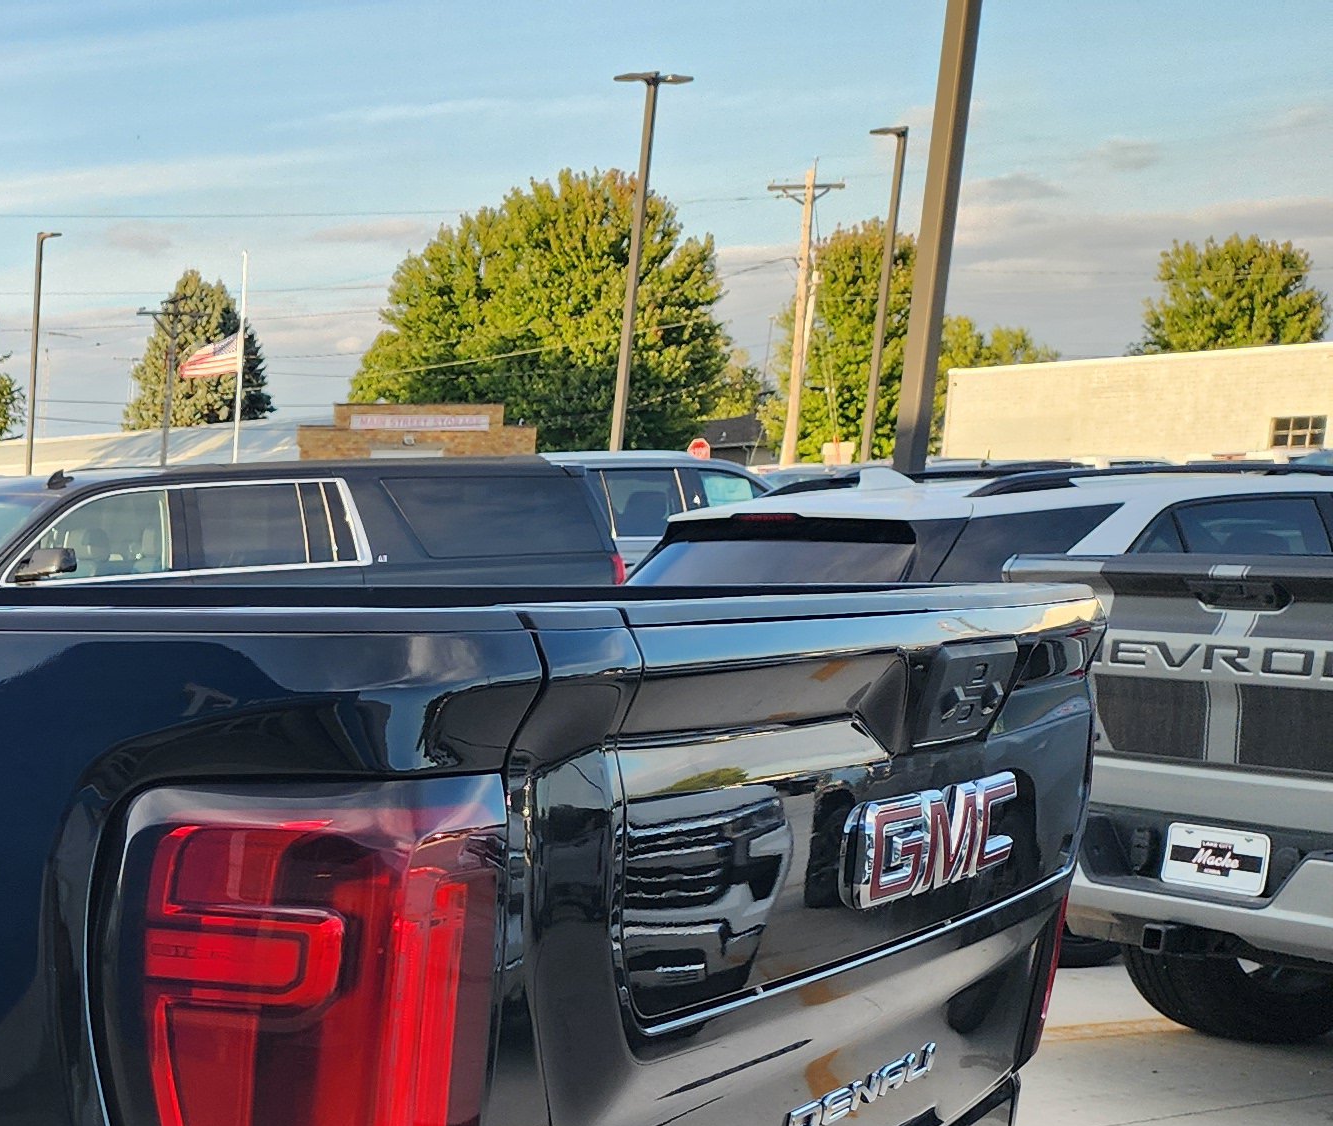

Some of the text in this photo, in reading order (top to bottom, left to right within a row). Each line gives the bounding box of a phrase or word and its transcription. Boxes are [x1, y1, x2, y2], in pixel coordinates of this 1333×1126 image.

[390, 416, 429, 428] STREET
[839, 771, 1018, 910] GMC
[1191, 848, 1240, 869] Macke
